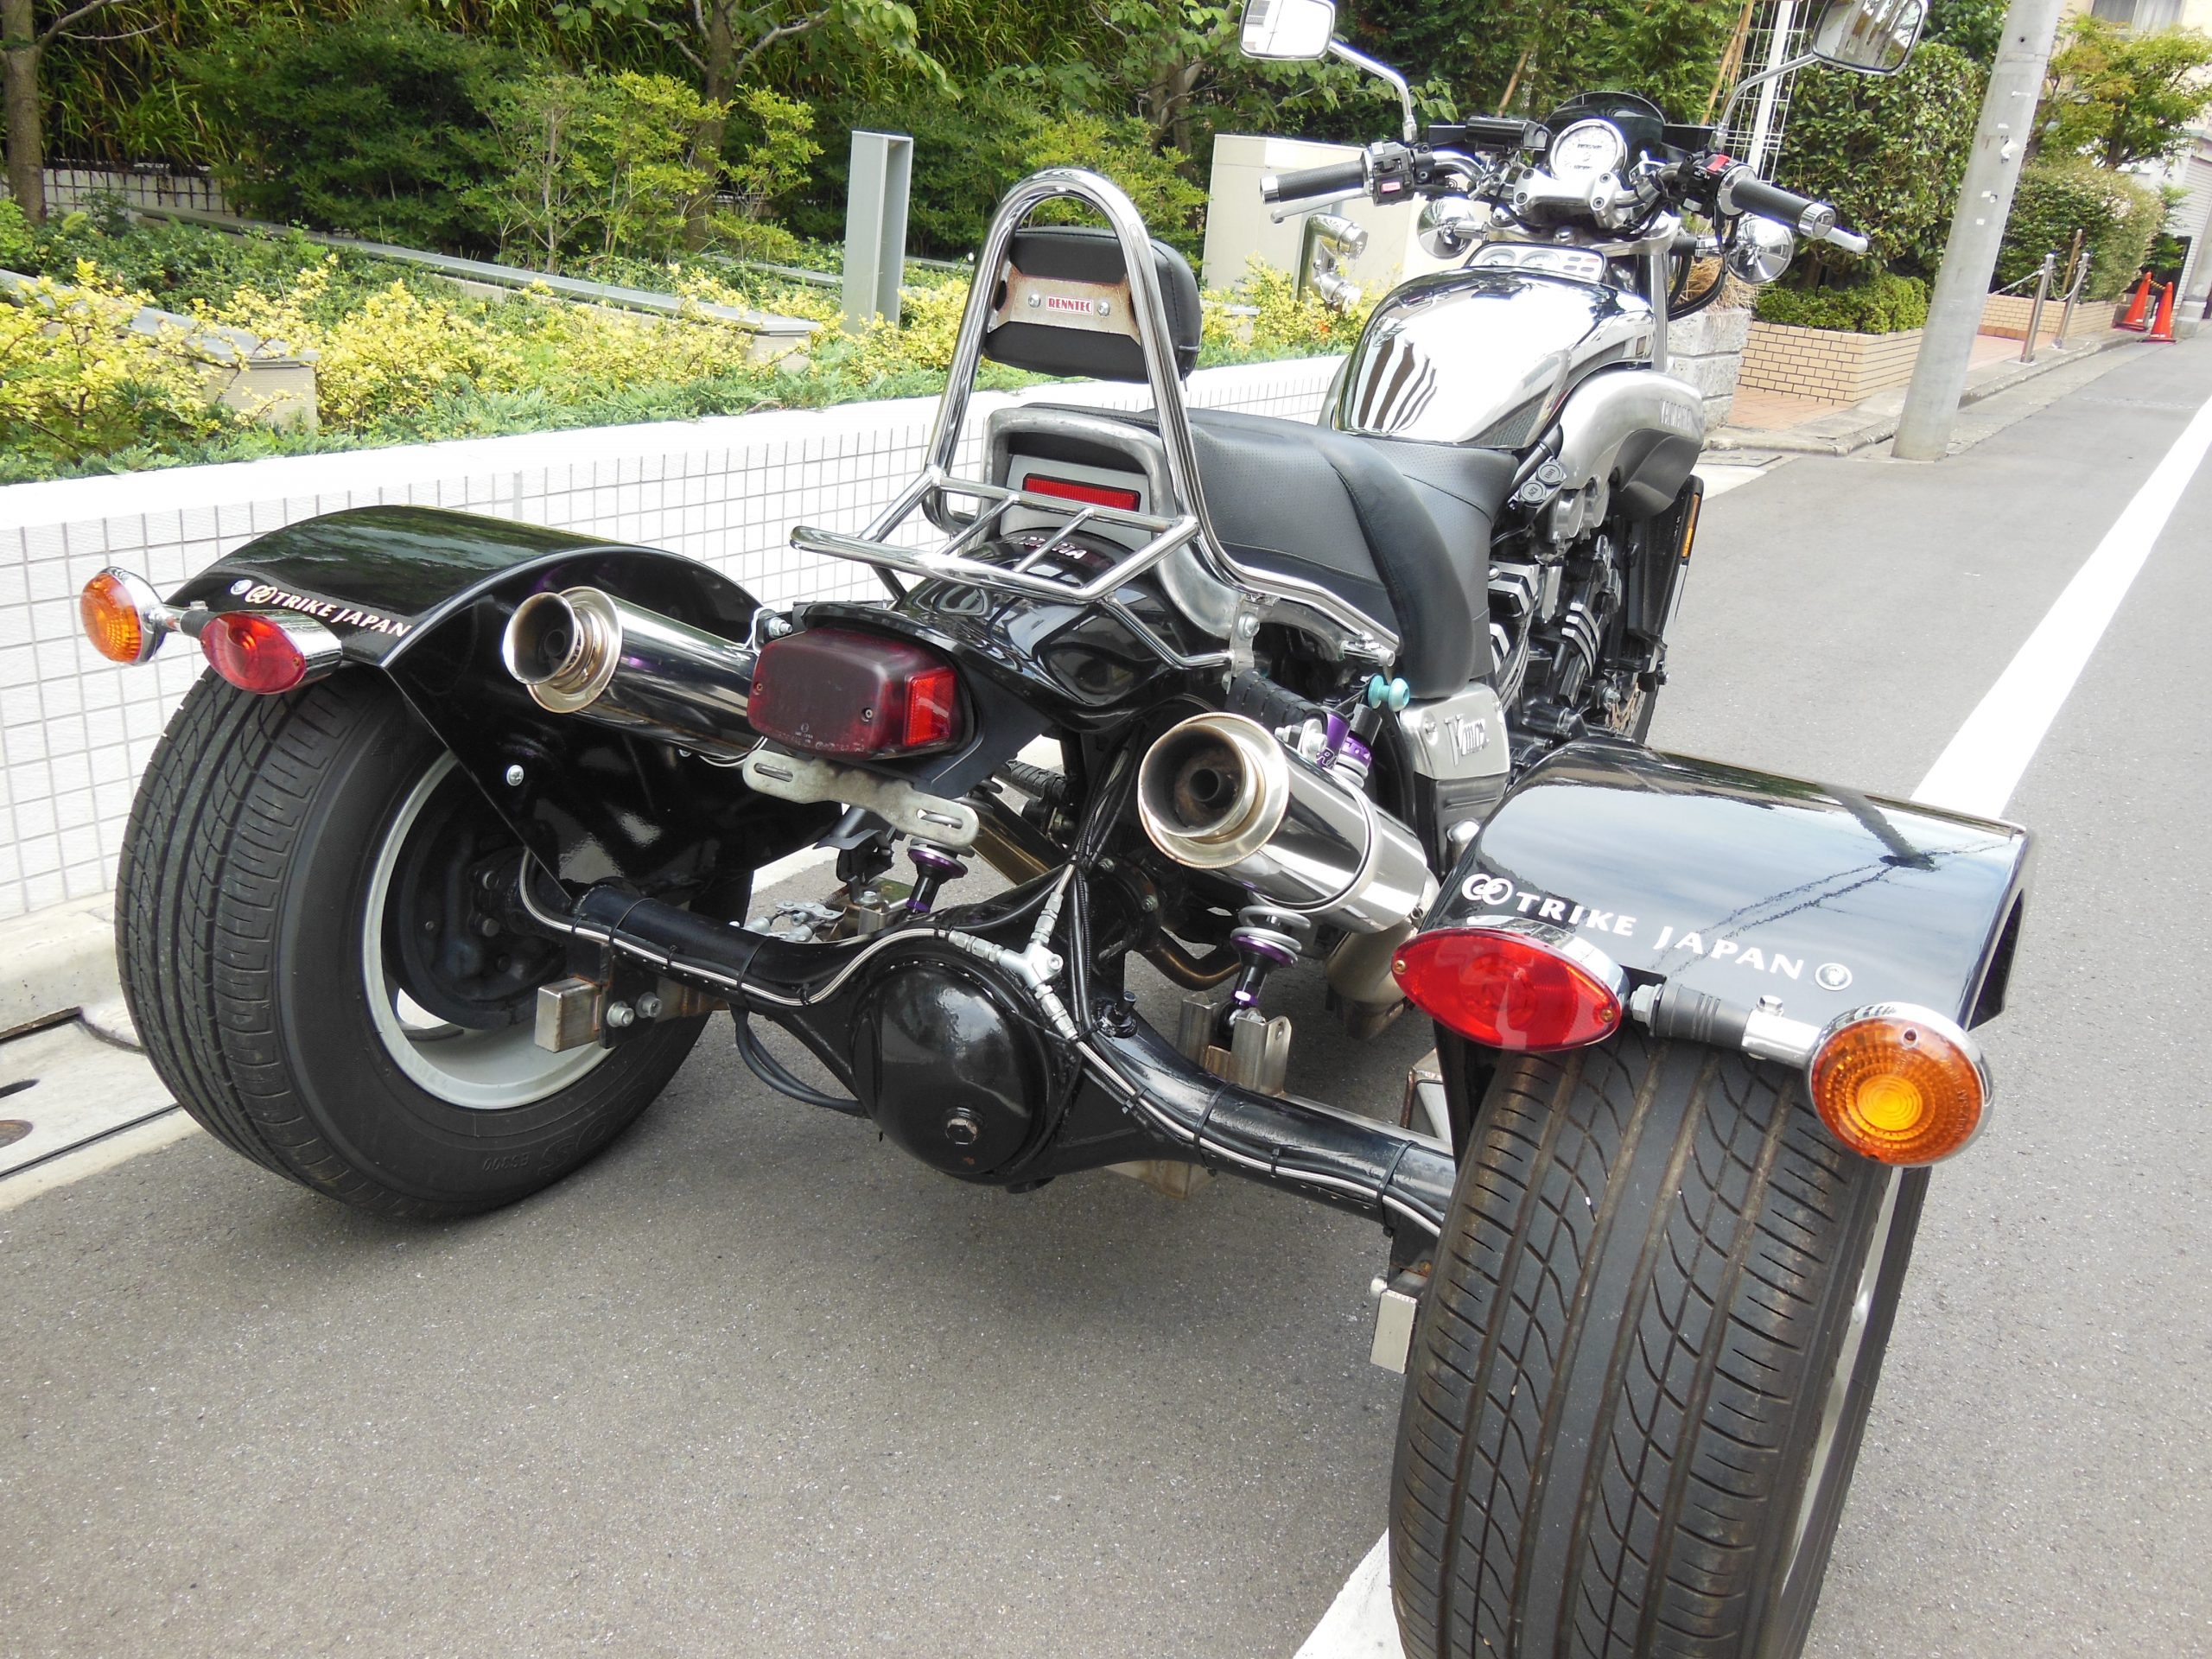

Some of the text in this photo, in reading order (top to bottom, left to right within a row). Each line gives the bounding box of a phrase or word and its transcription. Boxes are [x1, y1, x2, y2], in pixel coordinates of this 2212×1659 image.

[1048, 297, 1091, 313] RENNTEC
[271, 591, 413, 638] TRIKE JAPAN
[1516, 891, 1804, 981] TRIKE JAPAN
